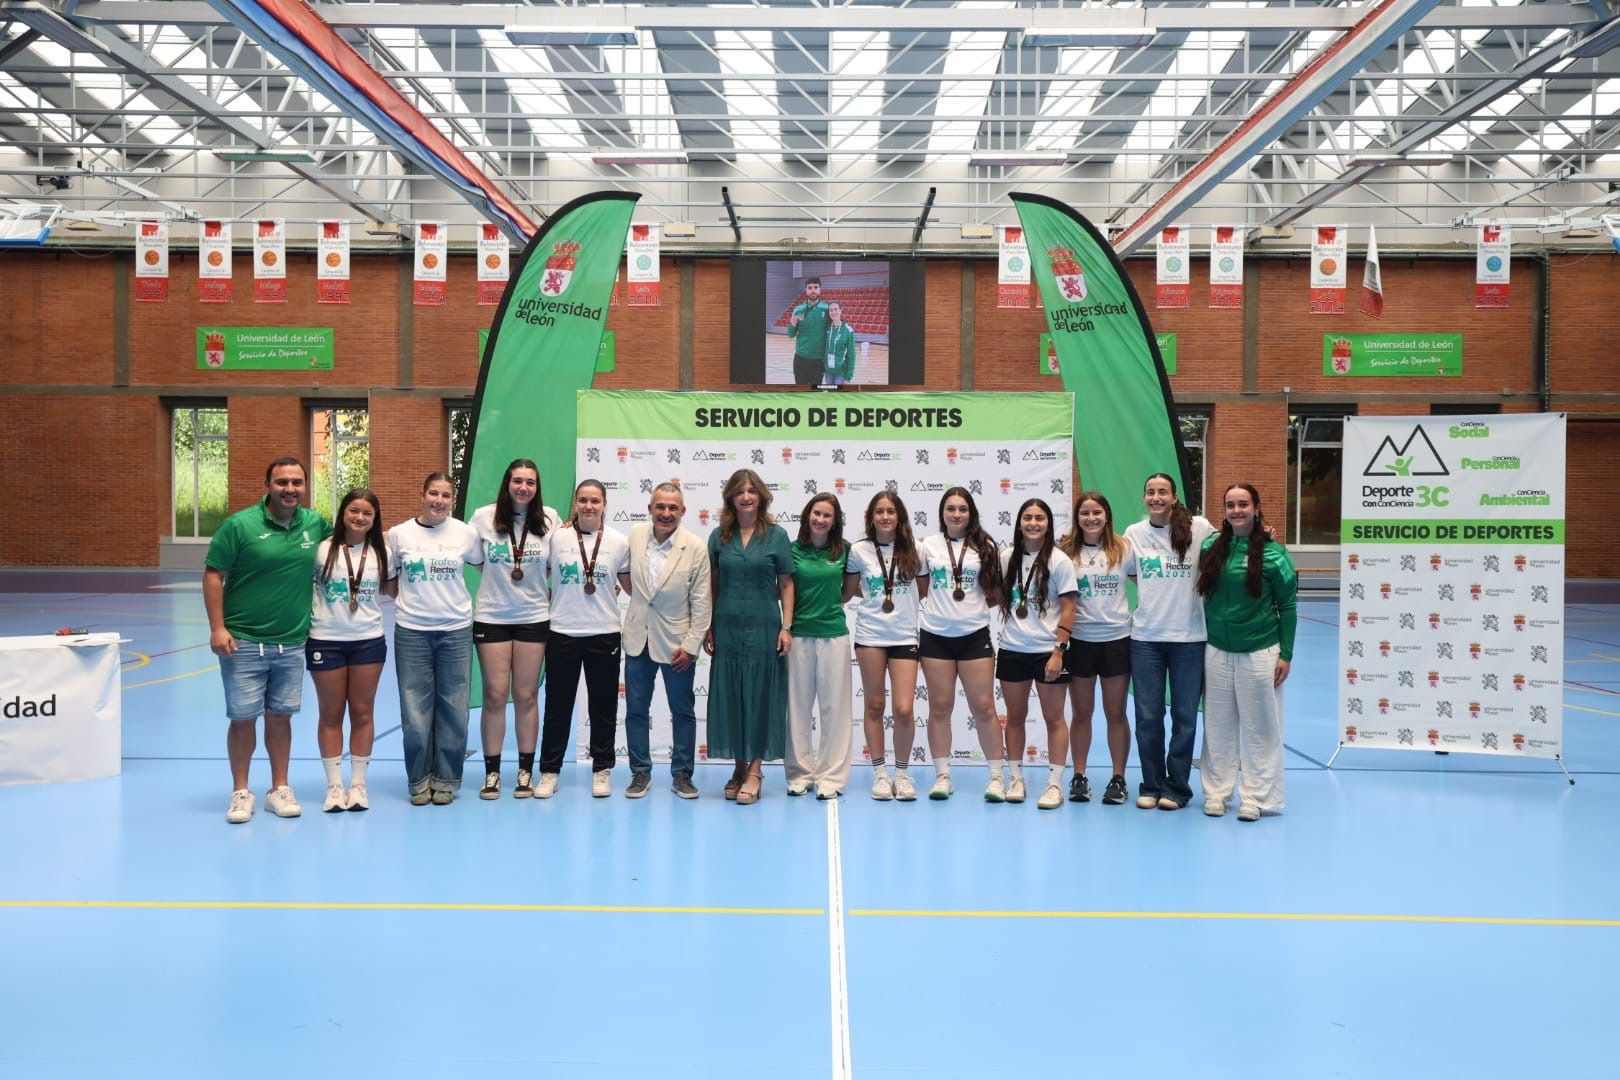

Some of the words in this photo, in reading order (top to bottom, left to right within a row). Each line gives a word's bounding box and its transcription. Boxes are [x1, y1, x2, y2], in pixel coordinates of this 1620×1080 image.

[518, 298, 602, 321] universidad
[237, 334, 288, 343] Universidad
[290, 335, 302, 343] de
[304, 334, 325, 343] León
[1363, 340, 1416, 349] Universidad
[1418, 341, 1430, 349] de
[1432, 340, 1454, 349] León
[238, 350, 266, 360] Servicio
[267, 348, 276, 358] de
[278, 349, 308, 358] Deportes
[1370, 359, 1398, 367] Servicio
[1400, 357, 1409, 365] de
[1411, 357, 1441, 366] Deportes
[695, 408, 801, 428] SERVICIO
[808, 408, 838, 427] DE
[845, 408, 963, 428] DEPORTES
[1449, 427, 1489, 438] Social
[1461, 457, 1520, 470] Personal
[1362, 486, 1414, 500] Deporte
[1416, 486, 1449, 507] 3C
[1480, 493, 1550, 506] Ambiental
[1353, 525, 1430, 539] SERVICIO
[1436, 525, 1457, 538] DE
[1464, 525, 1554, 539] DEPORTES
[429, 557, 458, 567] Trofeo
[430, 566, 457, 574] Rector
[1093, 574, 1119, 582] Trofeo
